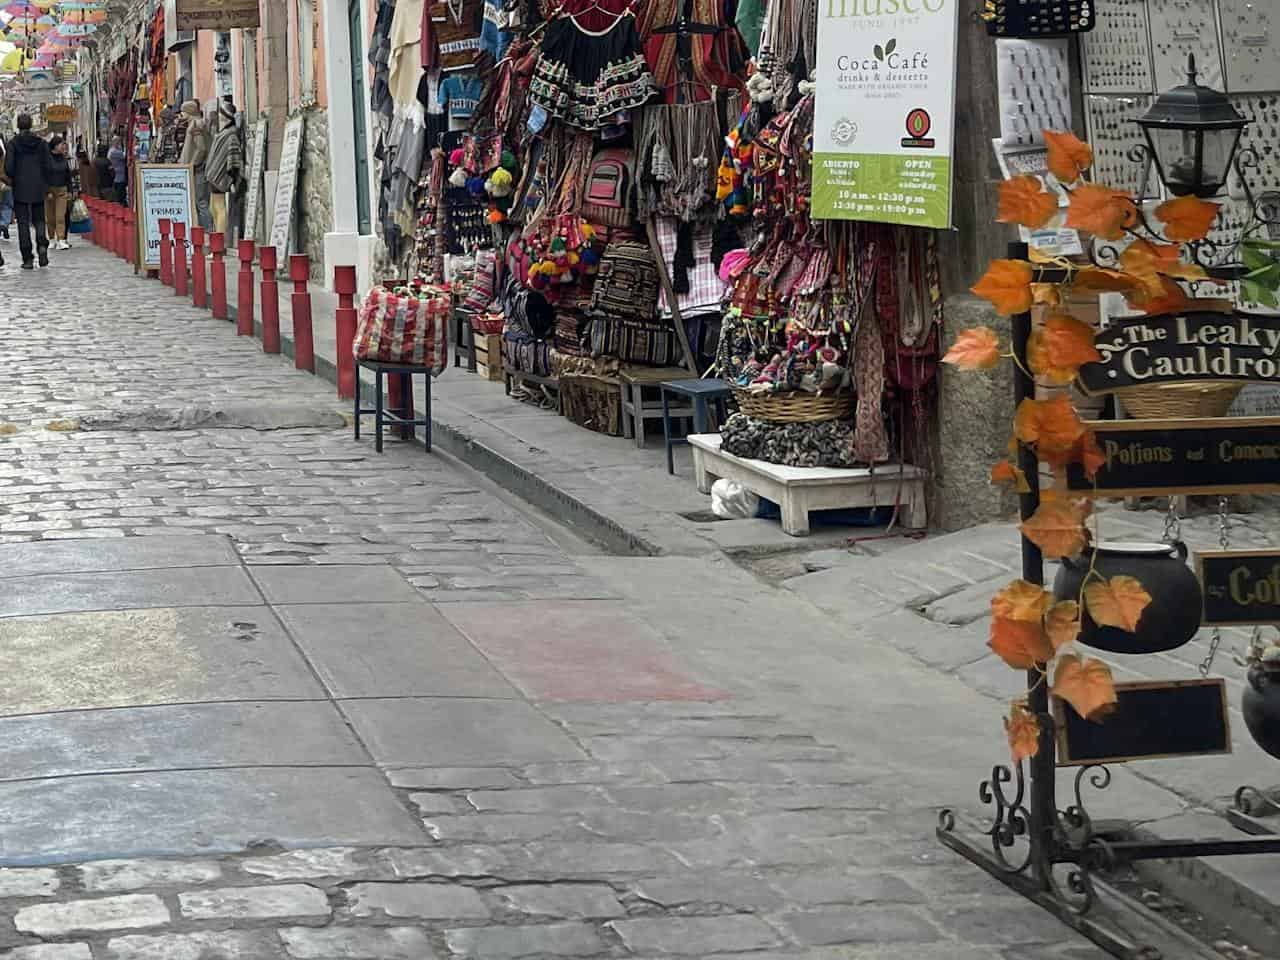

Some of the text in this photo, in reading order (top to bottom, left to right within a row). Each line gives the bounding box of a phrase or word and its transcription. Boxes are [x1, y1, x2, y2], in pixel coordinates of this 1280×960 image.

[837, 52, 928, 71] Coca Café
[838, 71, 869, 82] drinks
[886, 71, 928, 81] desserts
[822, 160, 860, 168] ABIERTO
[904, 160, 932, 168] OPEN
[1122, 317, 1280, 355] The Leaky
[1105, 440, 1173, 472] Potions
